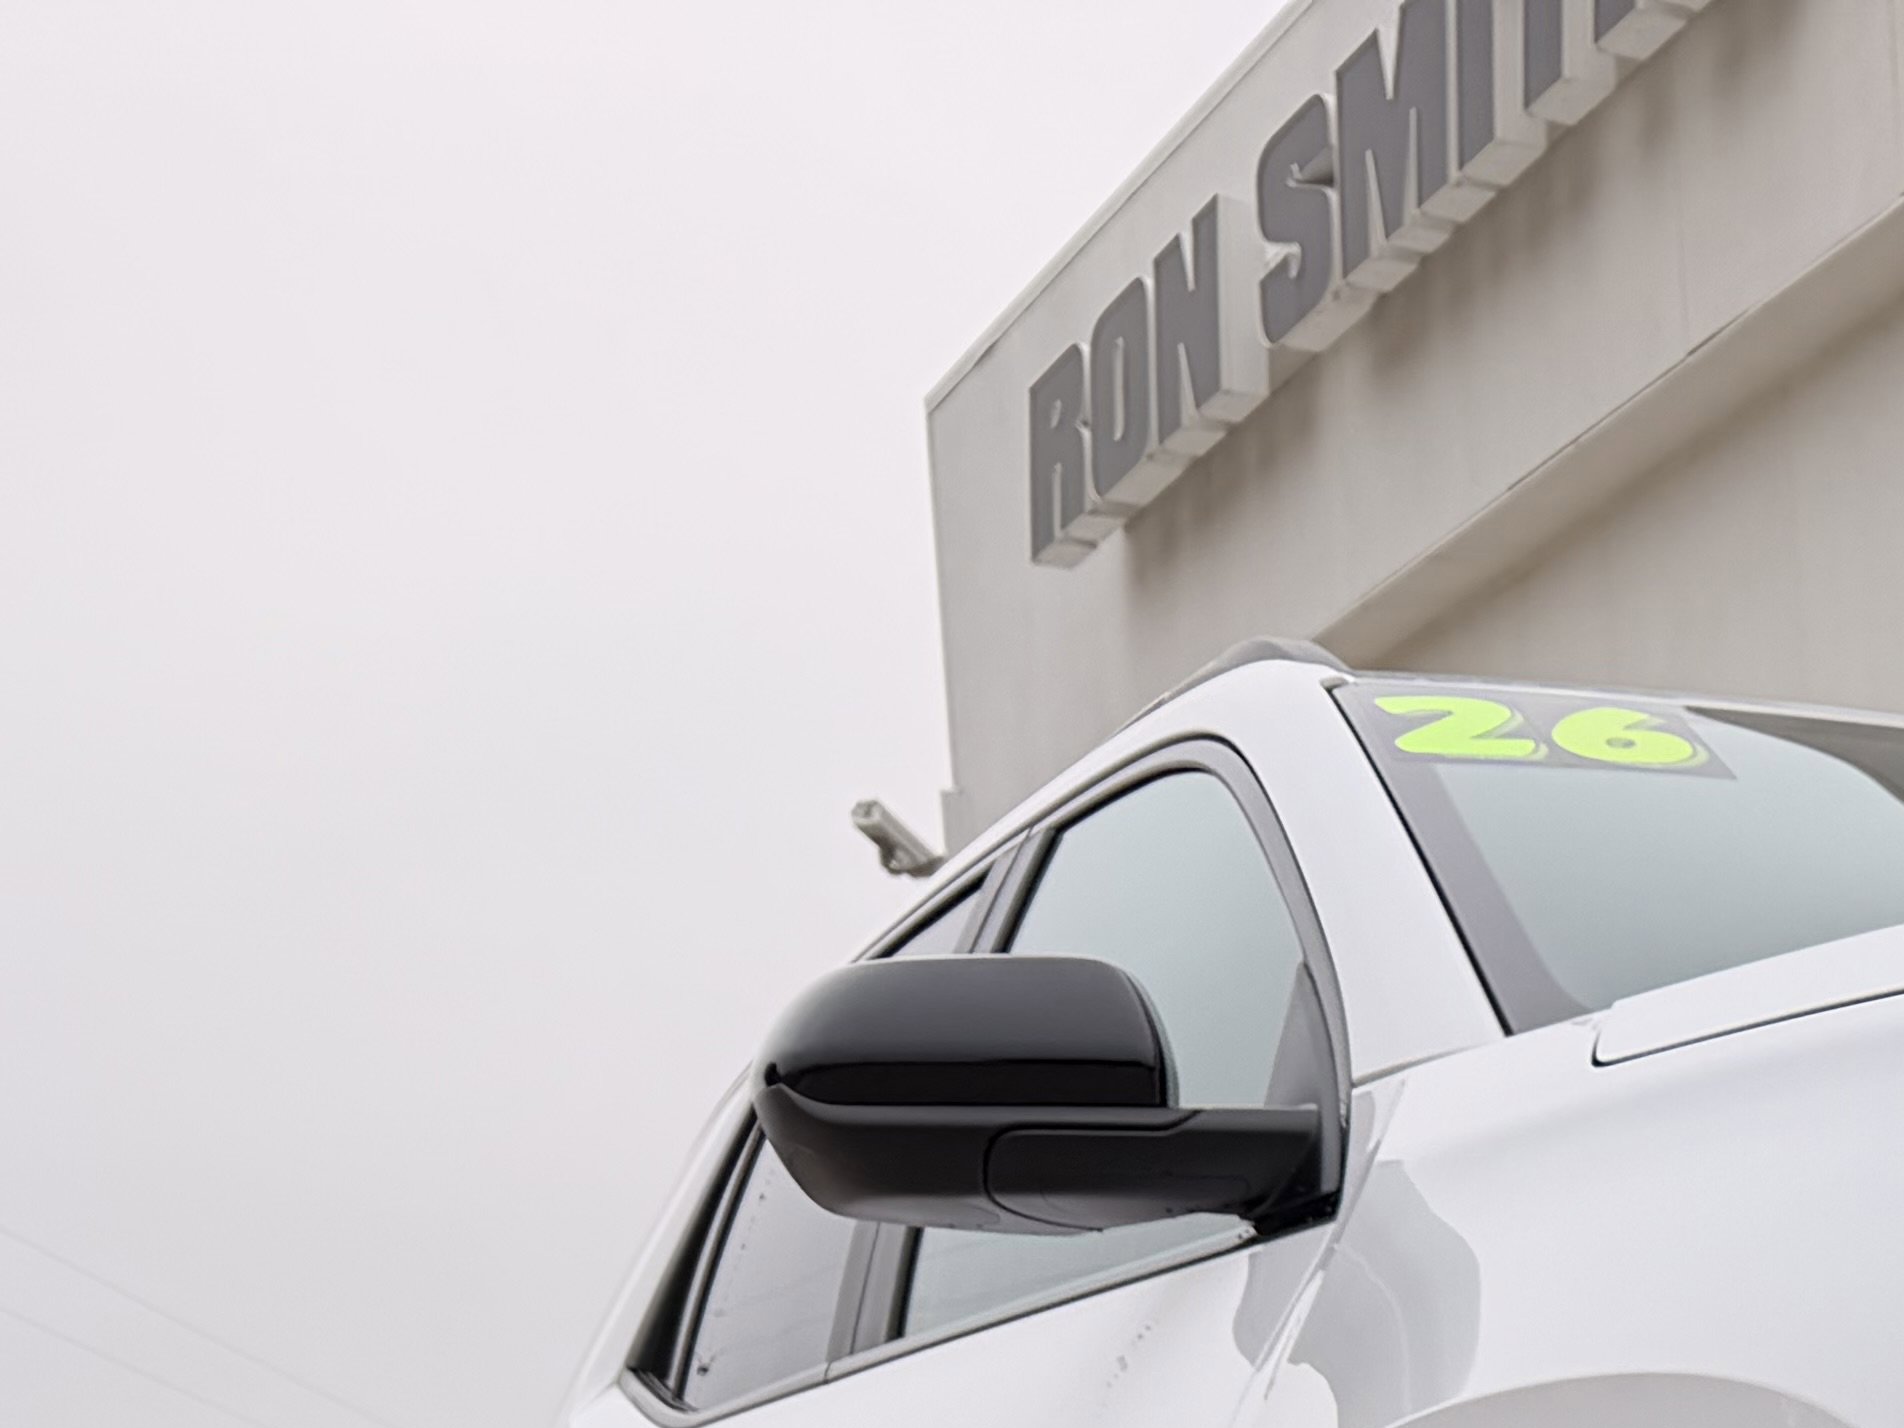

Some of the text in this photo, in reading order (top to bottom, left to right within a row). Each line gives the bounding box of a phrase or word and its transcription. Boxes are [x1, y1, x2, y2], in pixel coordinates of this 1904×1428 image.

[1029, 0, 1638, 565] RON SMI
[1374, 695, 1705, 768] 26
